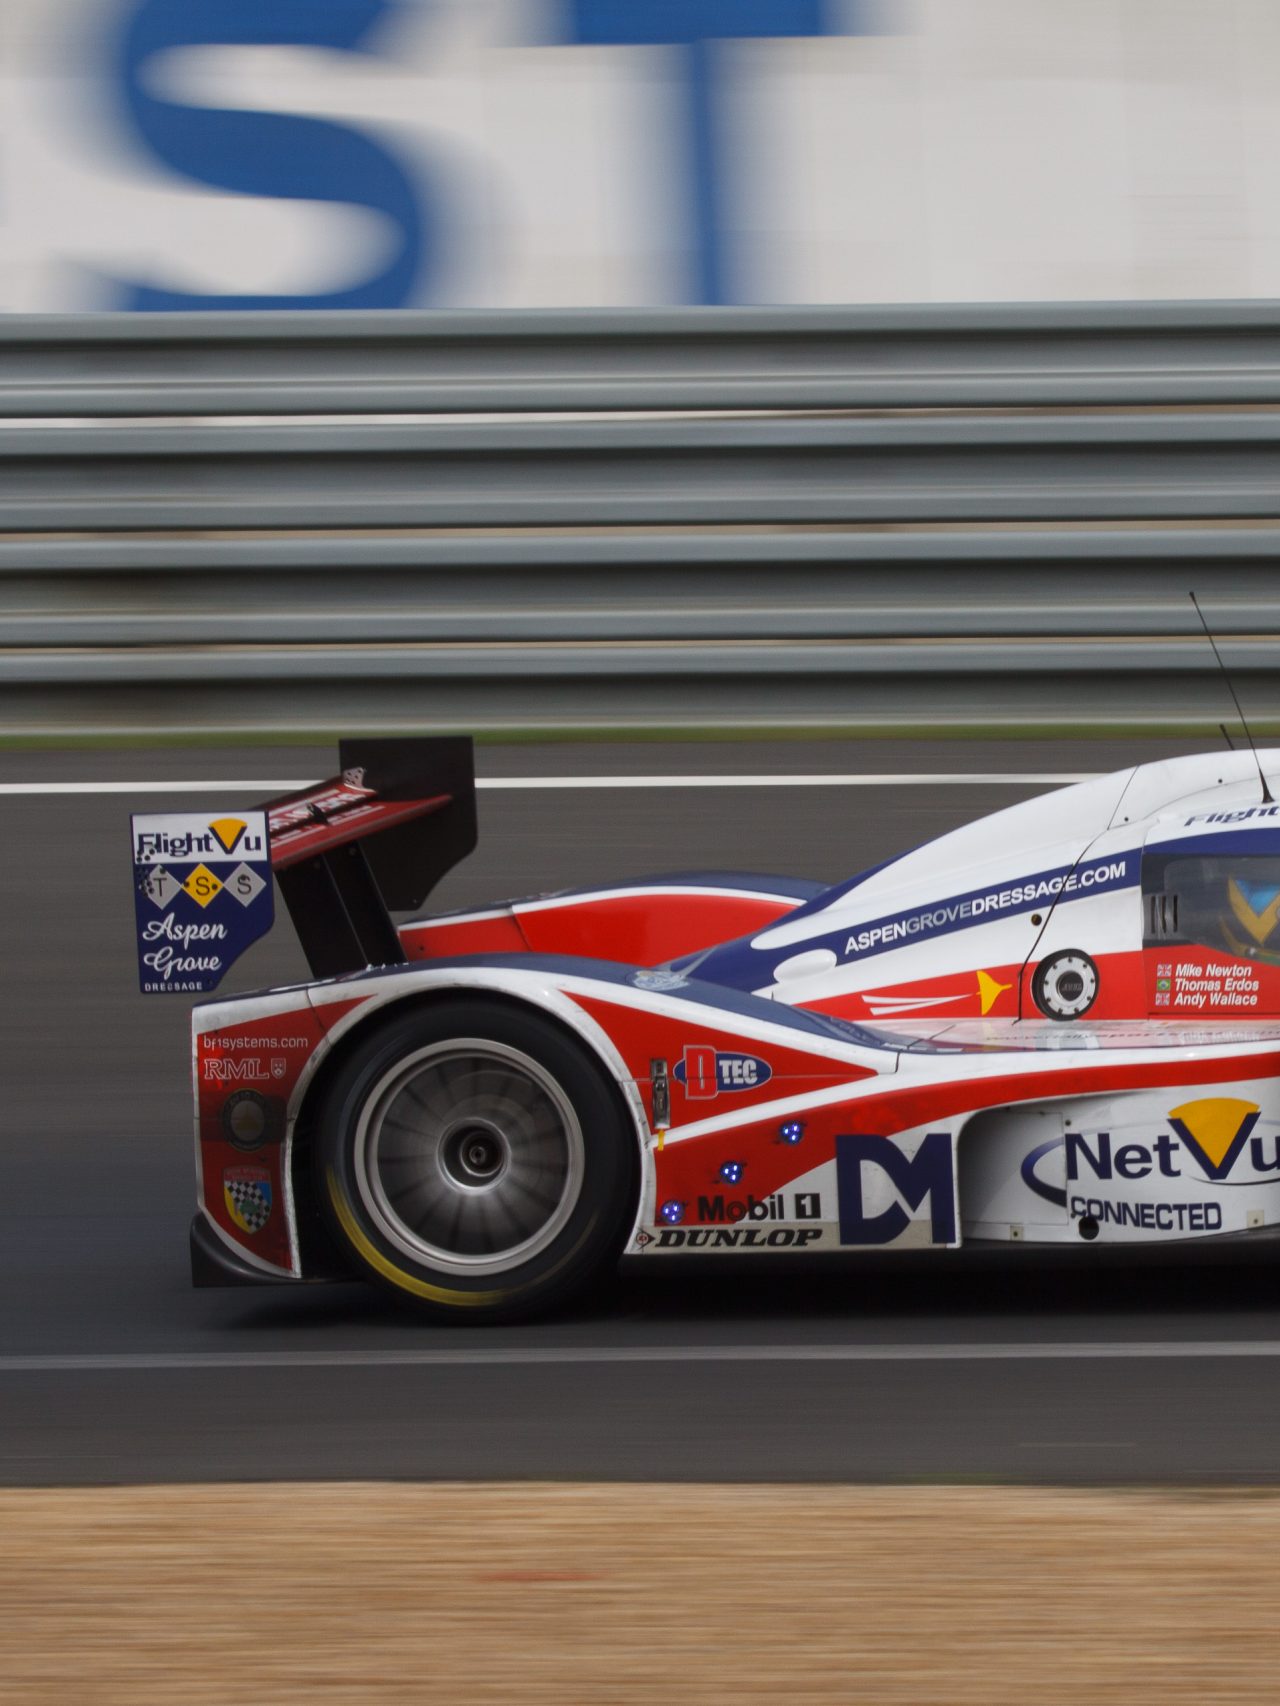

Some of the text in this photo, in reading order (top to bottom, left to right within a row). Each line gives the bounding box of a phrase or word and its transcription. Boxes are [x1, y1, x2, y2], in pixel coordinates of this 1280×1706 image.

[138, 819, 261, 857] FlightVu
[845, 861, 1126, 955] ASPENGROVEDRESSAGE.COM
[142, 912, 228, 950] Aspen
[143, 946, 222, 980] Grove
[1175, 963, 1252, 977] Mike Newton
[1174, 991, 1258, 1009] Andy Wallace
[1175, 978, 1260, 992] Thomas Erdos
[204, 1058, 270, 1080] RML
[834, 1133, 956, 1245] DM
[698, 1194, 818, 1222] Mobil 1
[1070, 1196, 1223, 1231] CONNECTED
[655, 1229, 823, 1248] DUNLOP
